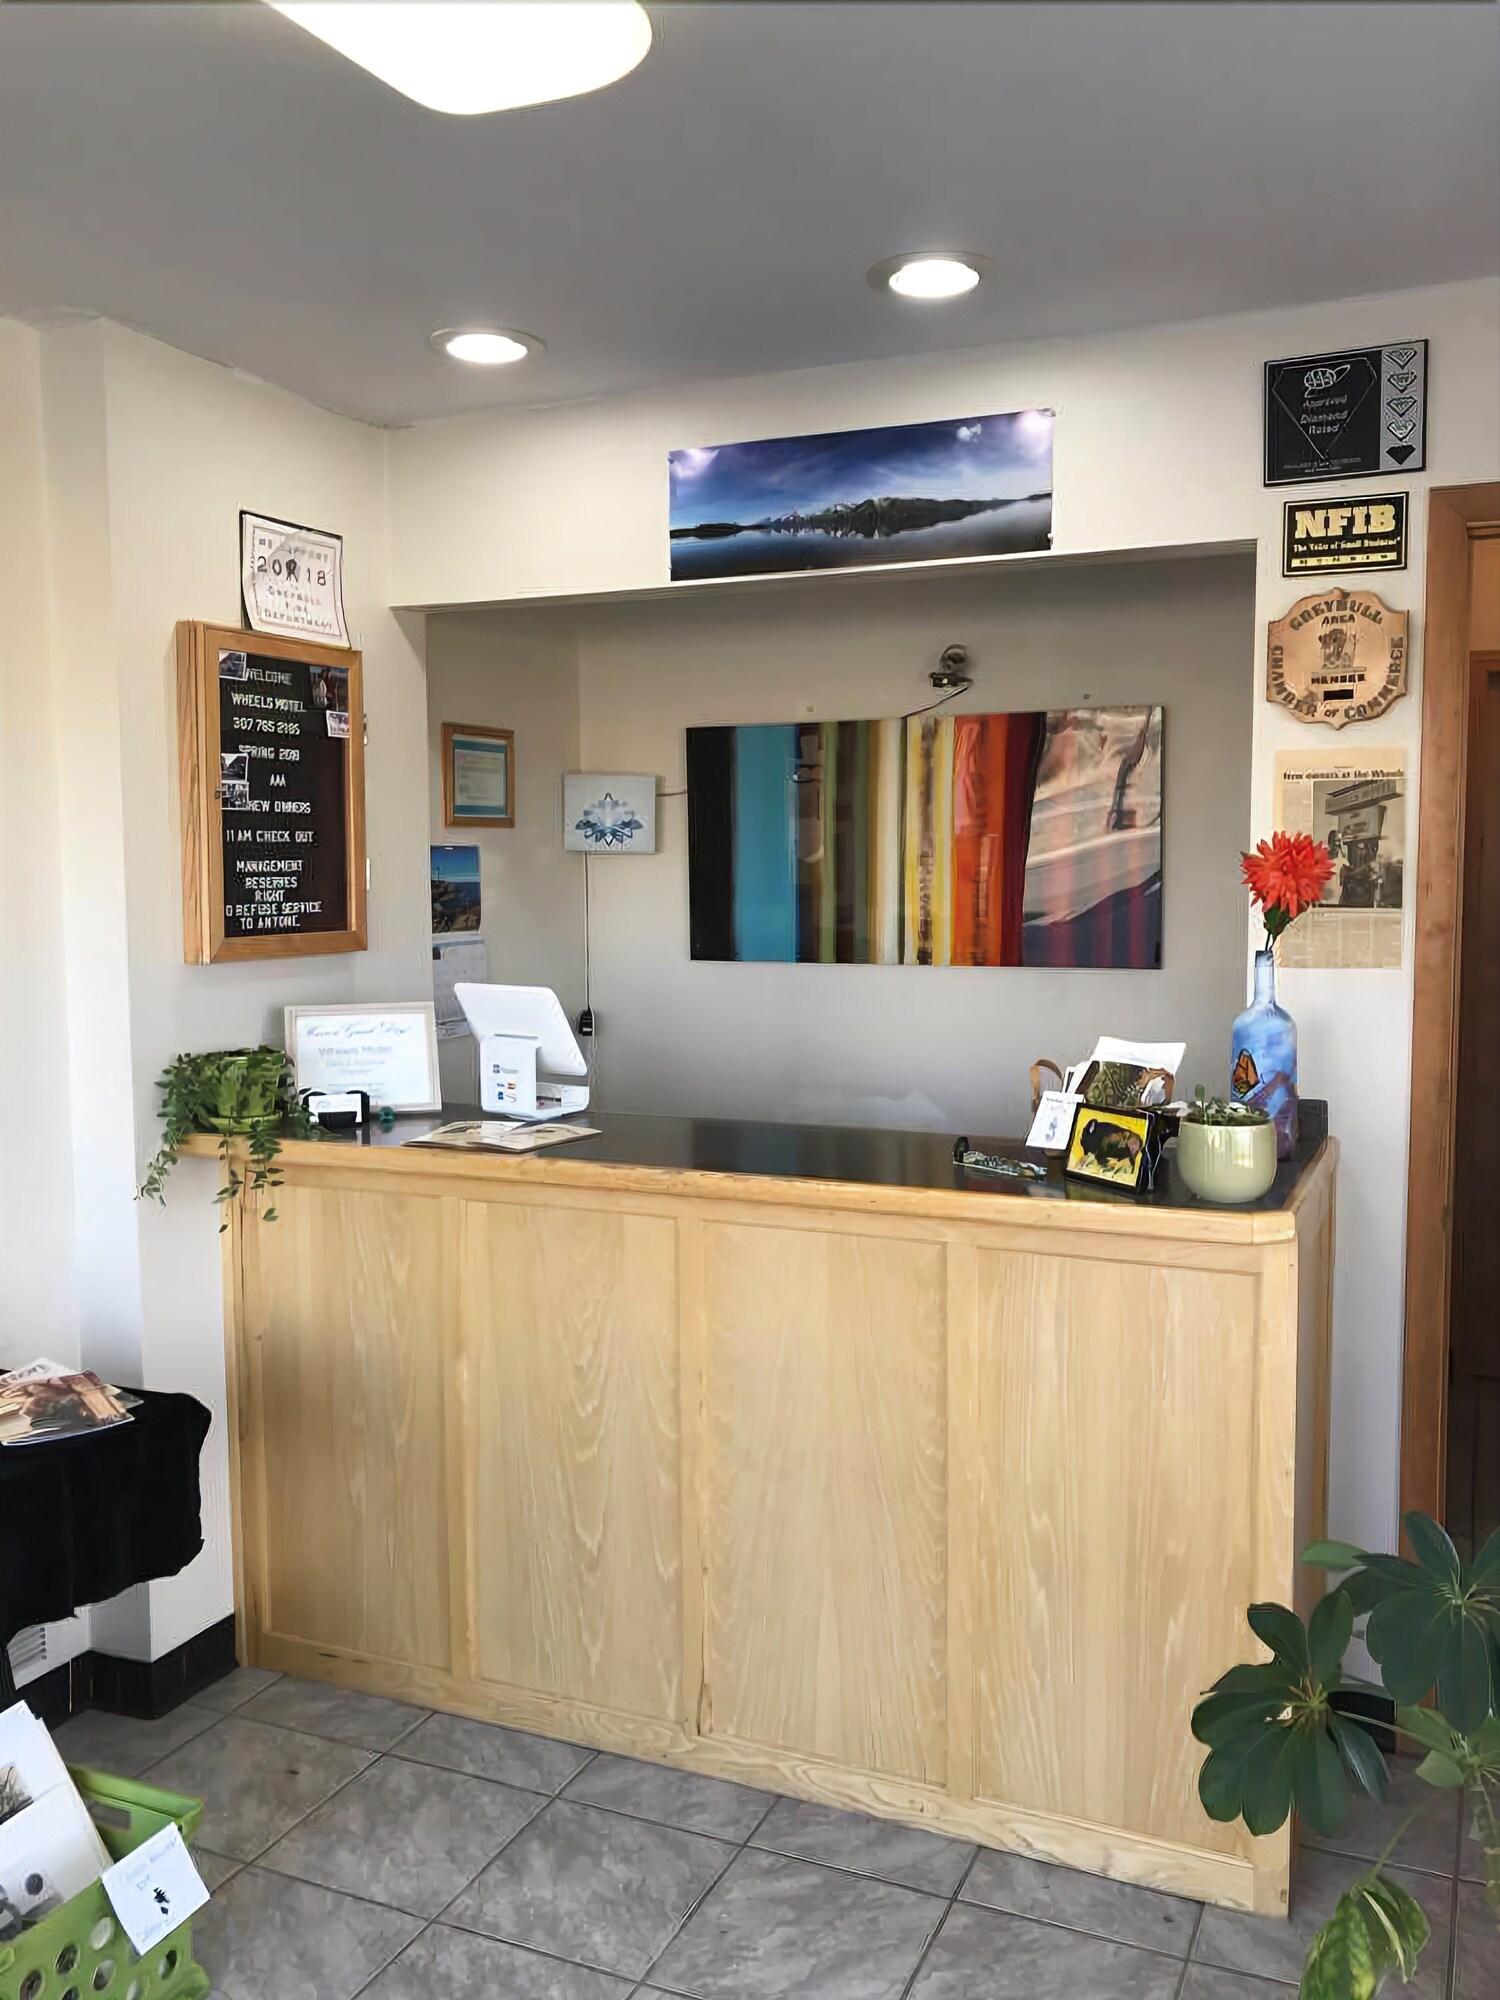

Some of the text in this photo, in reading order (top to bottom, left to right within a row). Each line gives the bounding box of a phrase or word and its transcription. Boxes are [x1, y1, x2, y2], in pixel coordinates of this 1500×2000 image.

[1294, 504, 1396, 539] NFIB
[1289, 599, 1383, 631] GREYBULL
[1321, 614, 1356, 627] AREA
[1344, 636, 1404, 719] COMMERCE
[231, 692, 307, 712] WHEELS MOTEL
[233, 717, 254, 731] 307
[256, 719, 275, 732] 765
[269, 774, 286, 787] AAA
[237, 830, 252, 842] AM
[256, 830, 291, 842] CHECK
[295, 831, 315, 843] OUT
[236, 860, 303, 872] MANAGEMENT
[245, 876, 298, 889] RESERVES
[235, 903, 278, 916] REFUSE
[281, 900, 322, 914] SERVICE
[239, 915, 301, 930] TO ANYONE
